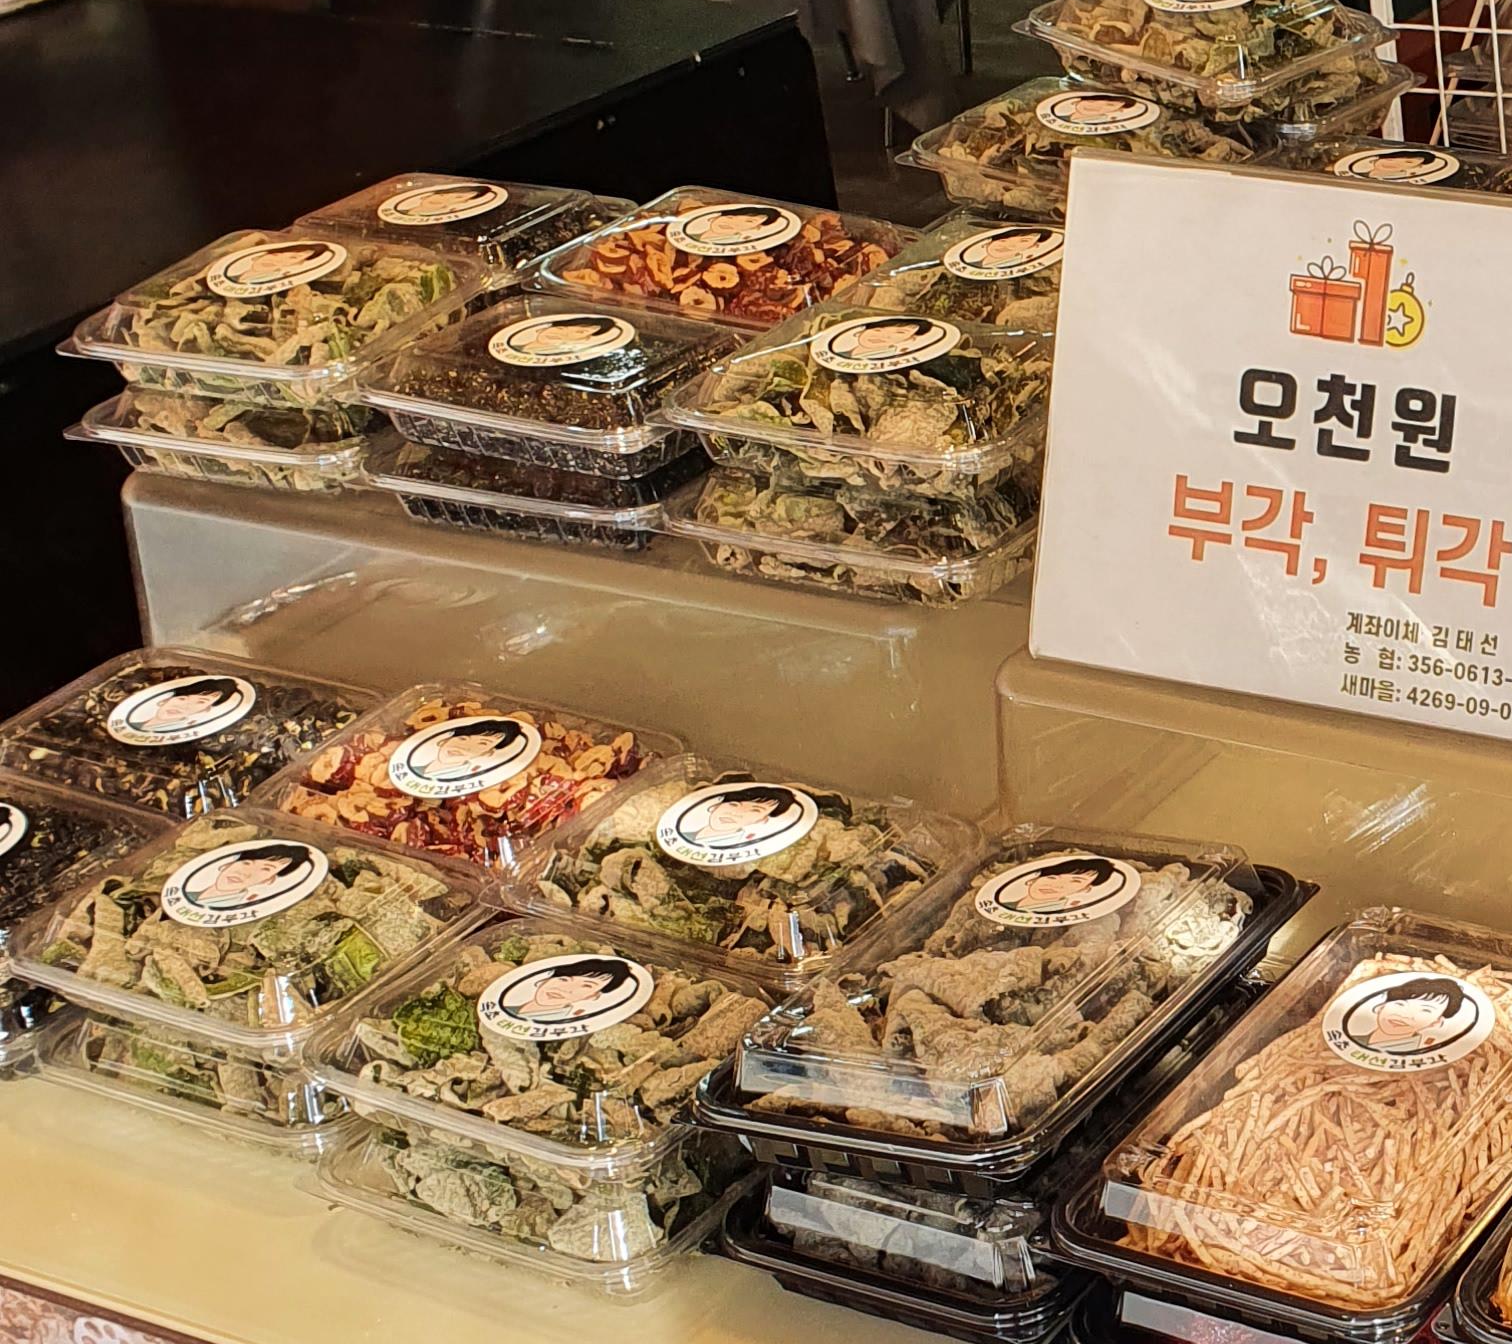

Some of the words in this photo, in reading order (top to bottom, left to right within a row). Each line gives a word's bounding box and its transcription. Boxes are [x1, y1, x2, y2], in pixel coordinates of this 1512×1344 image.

[1232, 366, 1459, 473] 오천원
[1167, 473, 1329, 585] 부각,
[1345, 611, 1420, 644] 계좌이체
[1340, 672, 1402, 703] 새마을:
